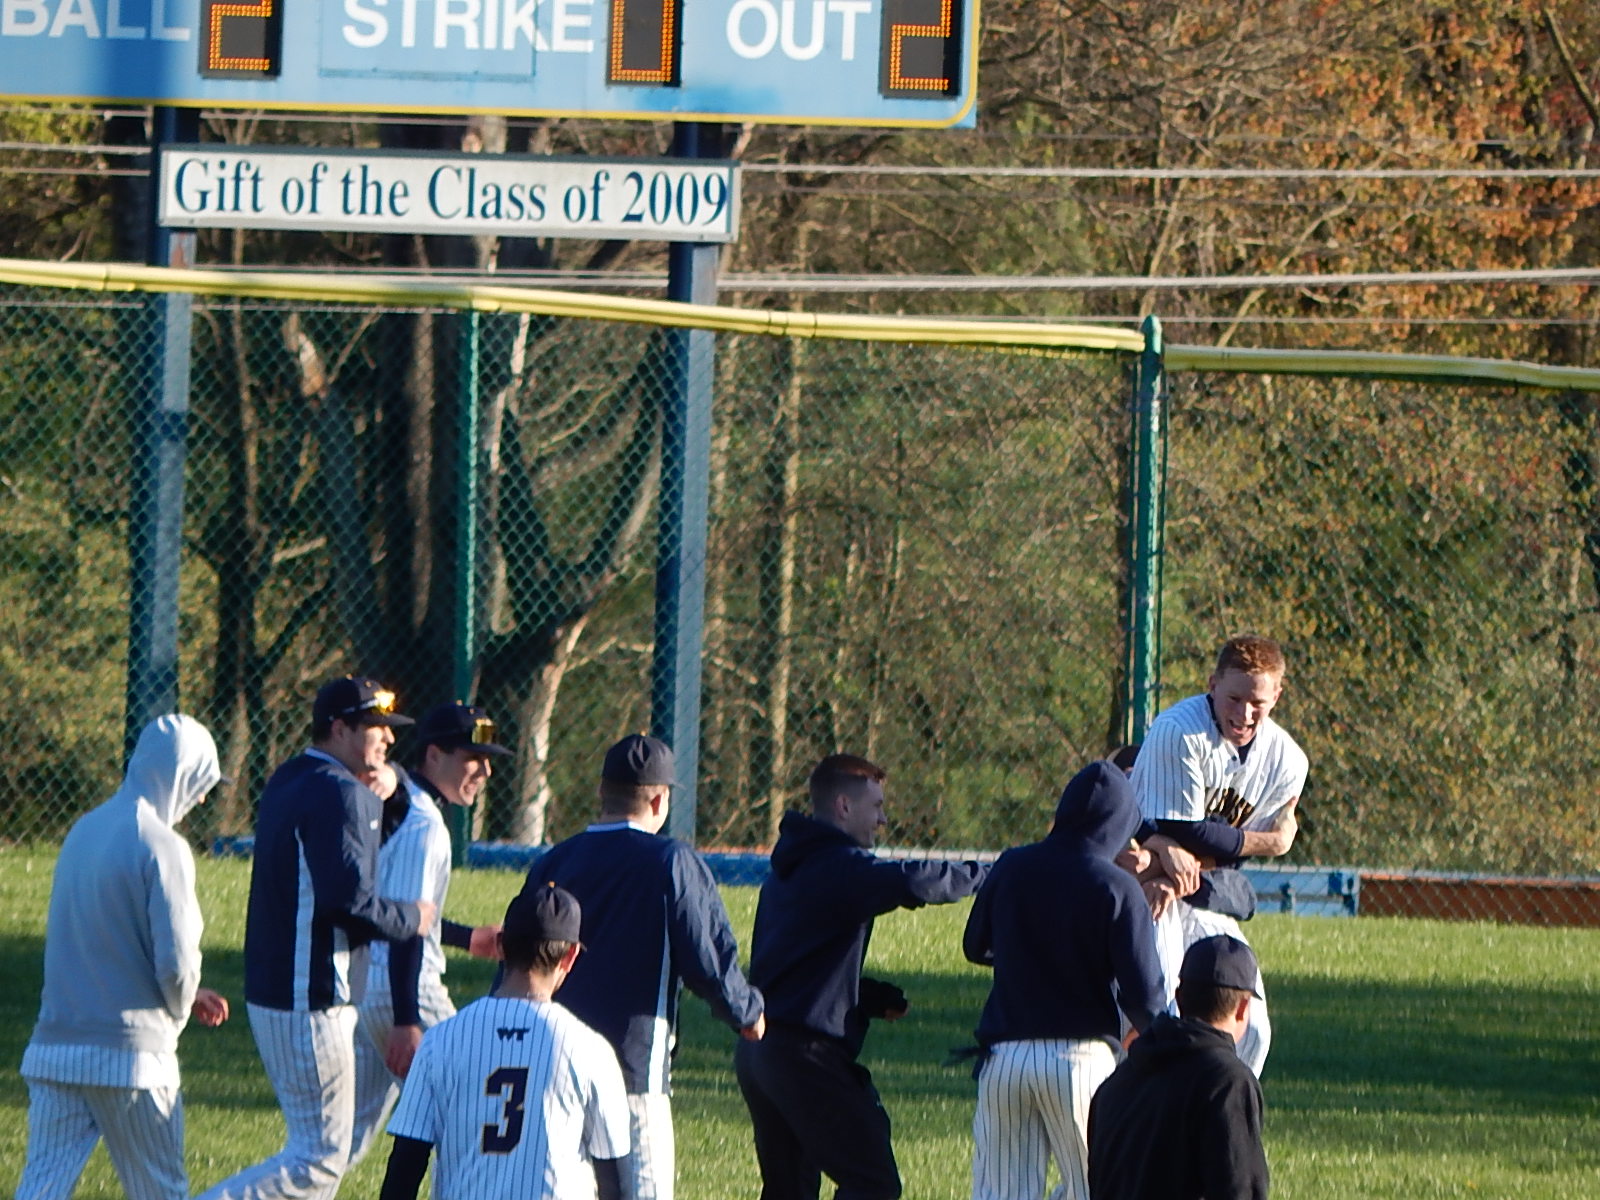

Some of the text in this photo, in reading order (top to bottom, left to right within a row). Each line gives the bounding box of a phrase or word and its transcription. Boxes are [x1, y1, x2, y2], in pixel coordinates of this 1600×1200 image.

[1, 0, 191, 41] BALL
[342, 0, 595, 54] STRIKE
[725, 0, 872, 61] OUT
[889, 0, 952, 91] 2
[174, 157, 729, 226] Gift of the Class of 2009
[480, 1066, 529, 1155] 3
